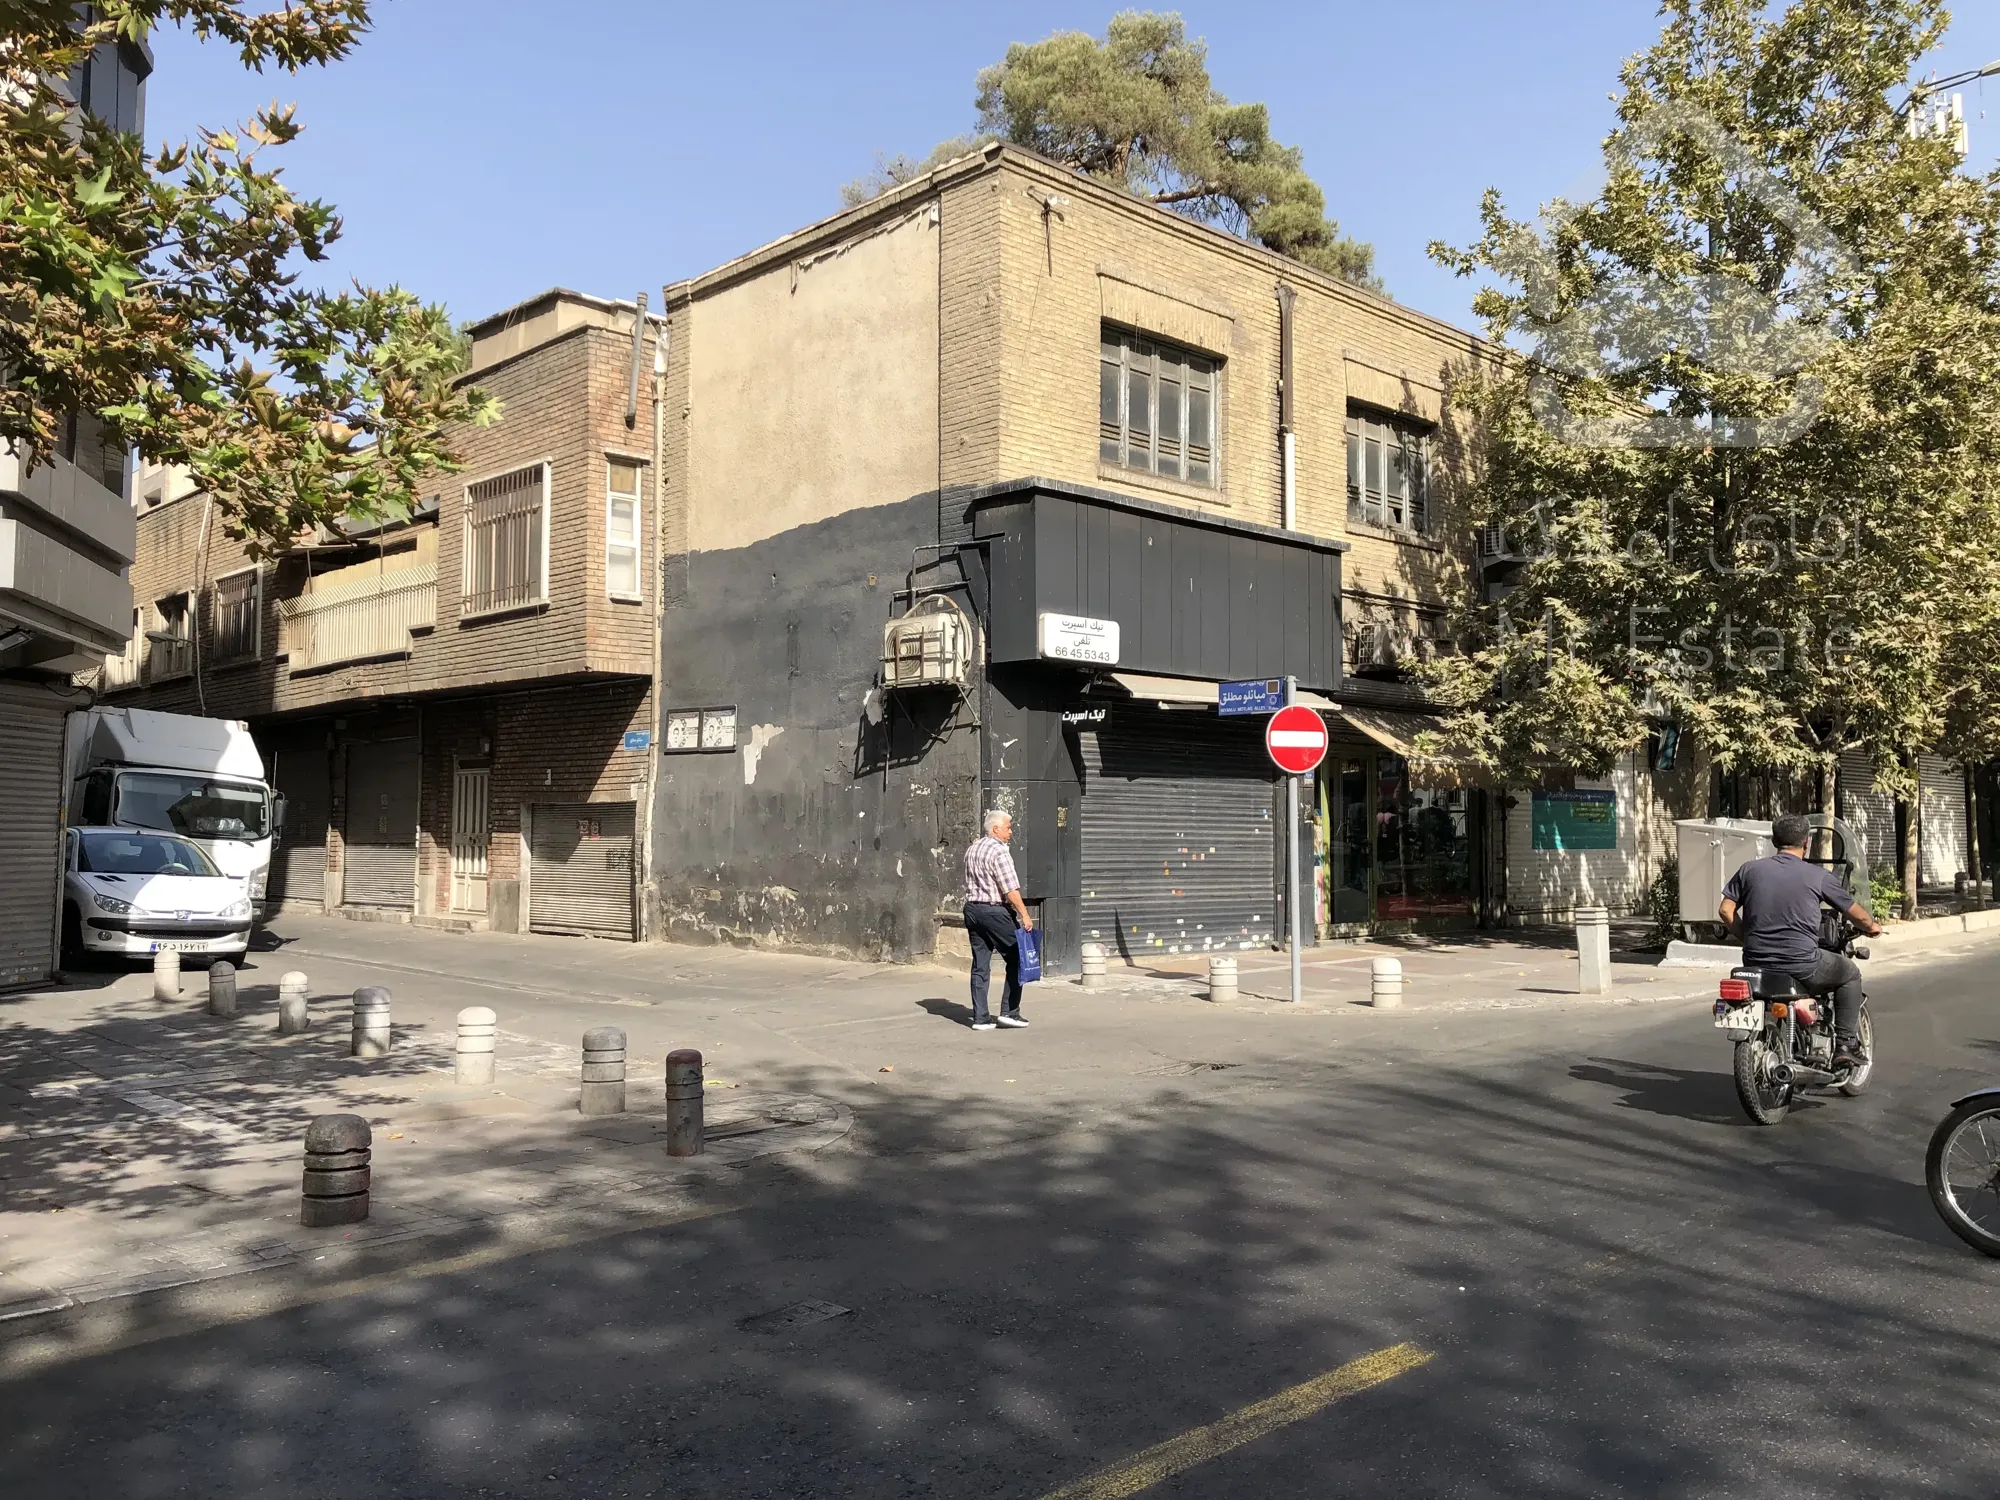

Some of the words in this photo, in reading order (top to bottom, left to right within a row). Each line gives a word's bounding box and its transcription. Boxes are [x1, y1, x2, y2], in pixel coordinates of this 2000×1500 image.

[1073, 634, 1091, 647] تلفن
[1219, 691, 1242, 706] مطلق
[1062, 709, 1089, 725] اسپرت
